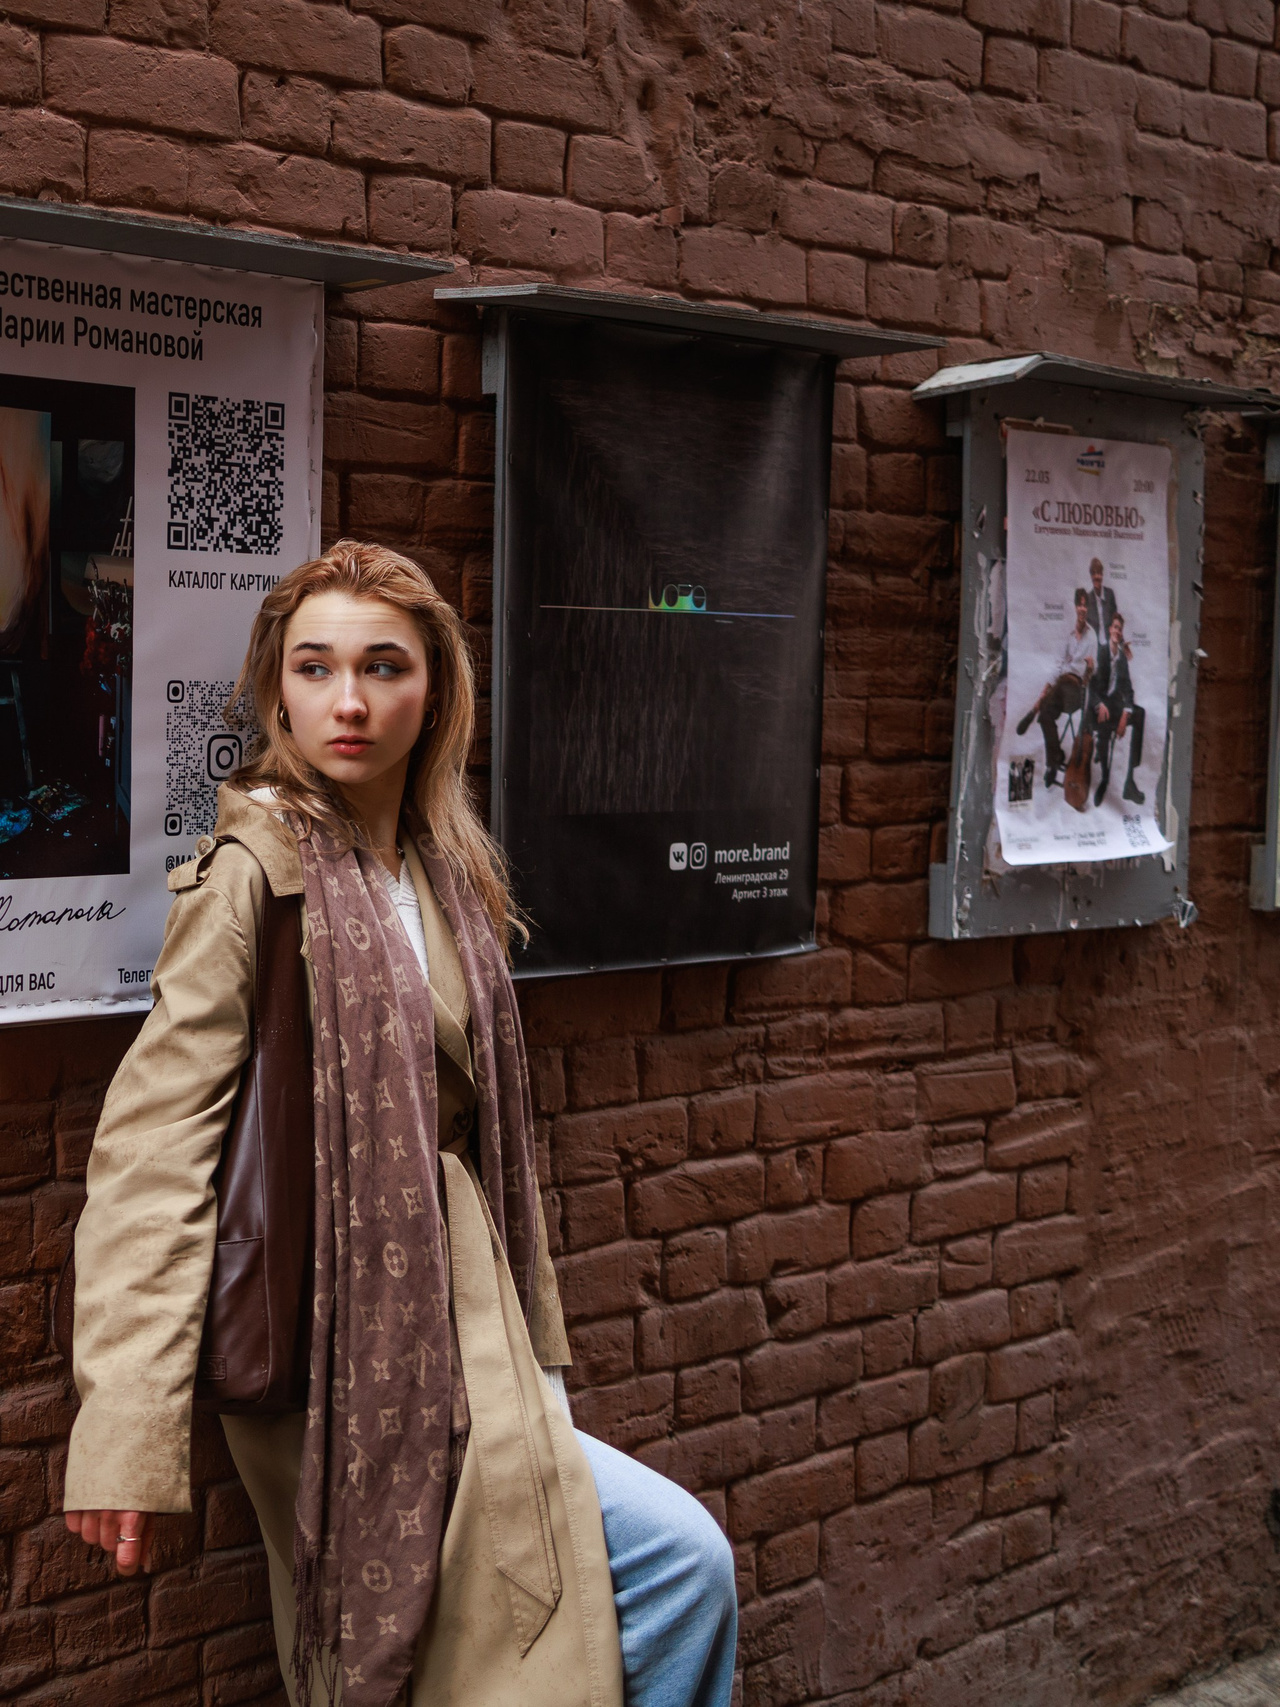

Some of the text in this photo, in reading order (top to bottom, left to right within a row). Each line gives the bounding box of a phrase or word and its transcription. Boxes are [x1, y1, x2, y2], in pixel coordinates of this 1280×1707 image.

[130, 287, 263, 328] мастерская
[73, 316, 204, 361] Романовой
[168, 569, 227, 590] КАТАЛОГ
[714, 841, 790, 864] more.brand
[714, 868, 789, 886] Ленинградская 29
[731, 886, 788, 903] Артист 3 этаж
[28, 971, 57, 991] ВАС
[117, 968, 154, 985] Телег
